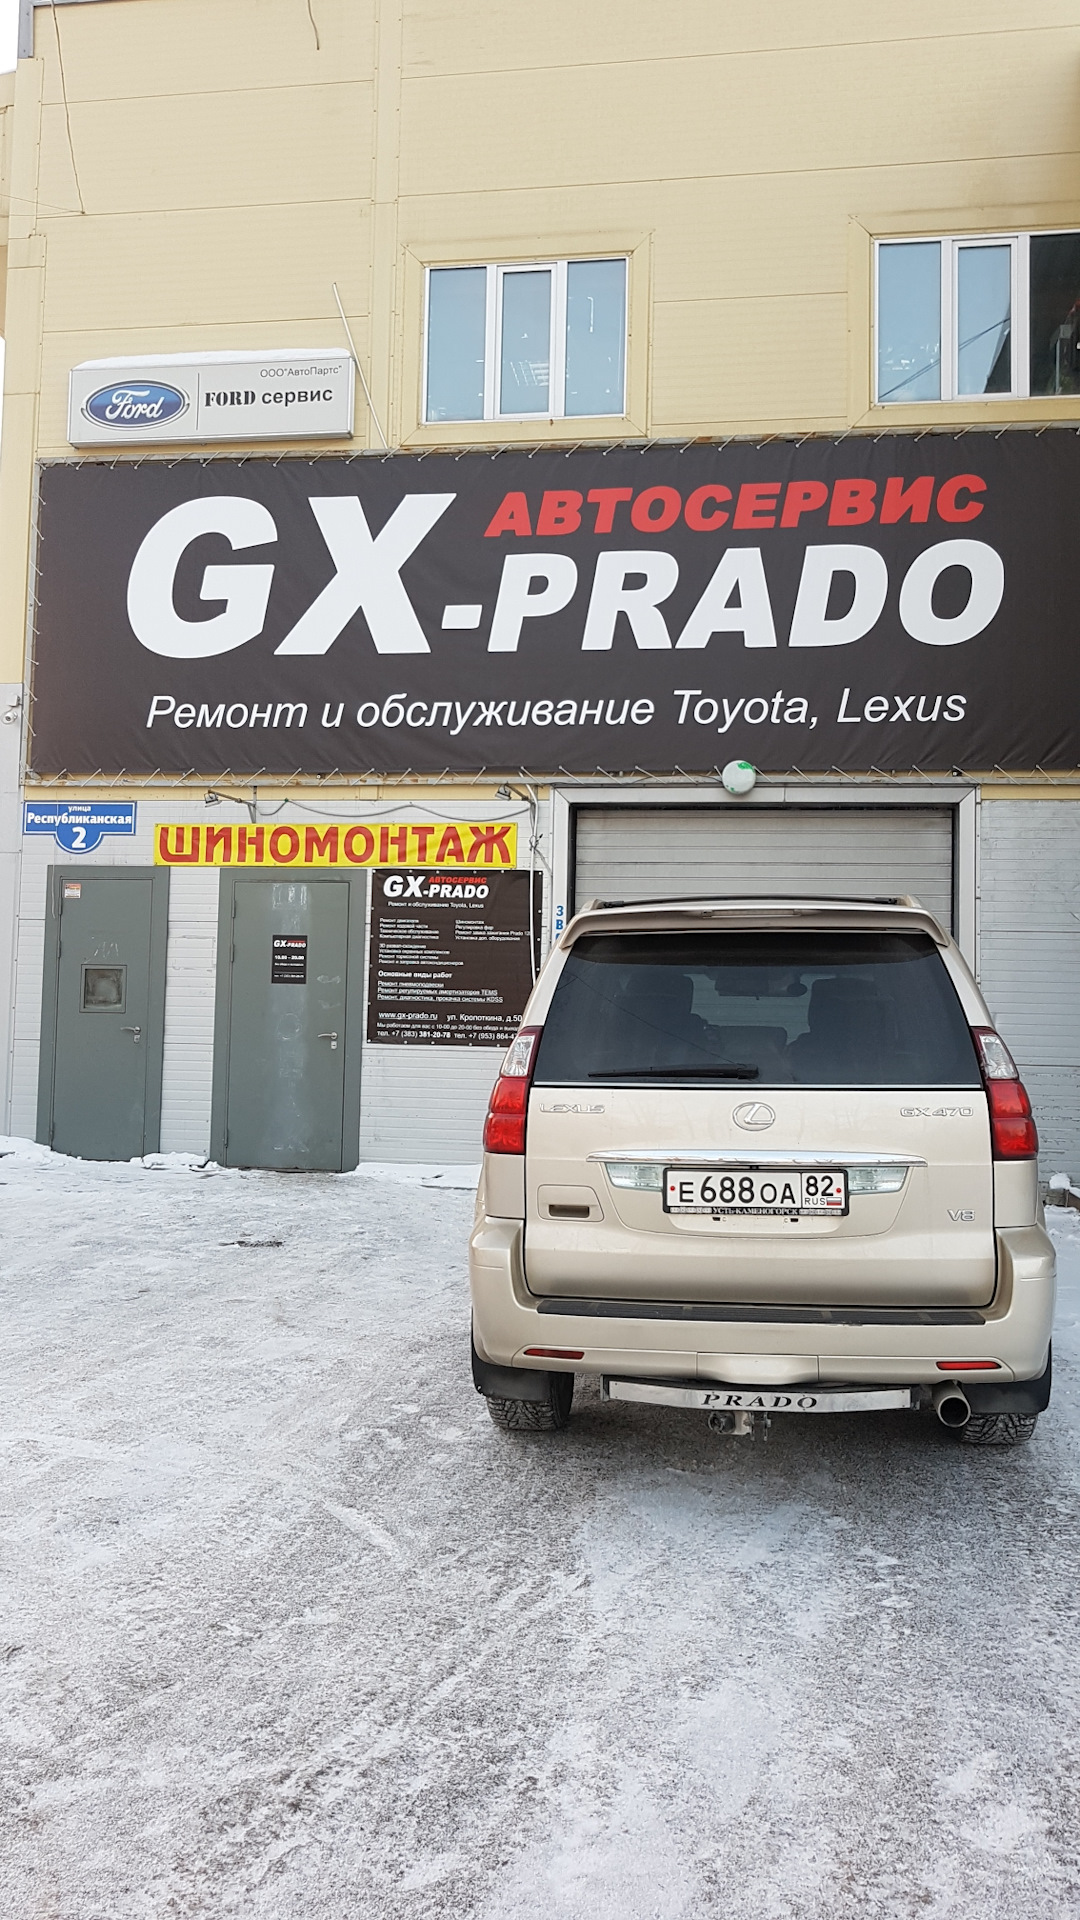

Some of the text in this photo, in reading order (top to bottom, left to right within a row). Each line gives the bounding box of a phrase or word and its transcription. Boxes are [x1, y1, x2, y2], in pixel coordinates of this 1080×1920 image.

[260, 365, 342, 378] ООО"АвтоПартс"
[105, 389, 163, 419] Ford
[204, 388, 333, 407] FORD сервис
[484, 474, 987, 537] АВТОСЕРВИС
[126, 492, 1006, 659] GX-PRADO
[146, 689, 968, 735] Ремонт и обслуживание Toyota, Lexus
[68, 804, 92, 813] улица
[27, 813, 132, 828] Республиканская
[71, 826, 87, 849] 2
[158, 825, 511, 864] ШИНОМОНТАЖ
[383, 875, 489, 899] GX-PRADO
[428, 876, 487, 884] АВТОСЕРВИС
[432, 971, 452, 979] работ
[378, 1012, 438, 1020] www.gx-prado.ru
[446, 1014, 458, 1022] ул.
[459, 1013, 504, 1022] Кропоткина,
[539, 1103, 606, 1114] LEXUS
[900, 1106, 975, 1117] GX 470
[805, 1175, 834, 1197] 82
[804, 1197, 826, 1206] RUS
[712, 1207, 799, 1216] УСТЬ-КАМЕНОГОРСК
[947, 1209, 976, 1222] V8
[701, 1393, 819, 1409] PRADO
